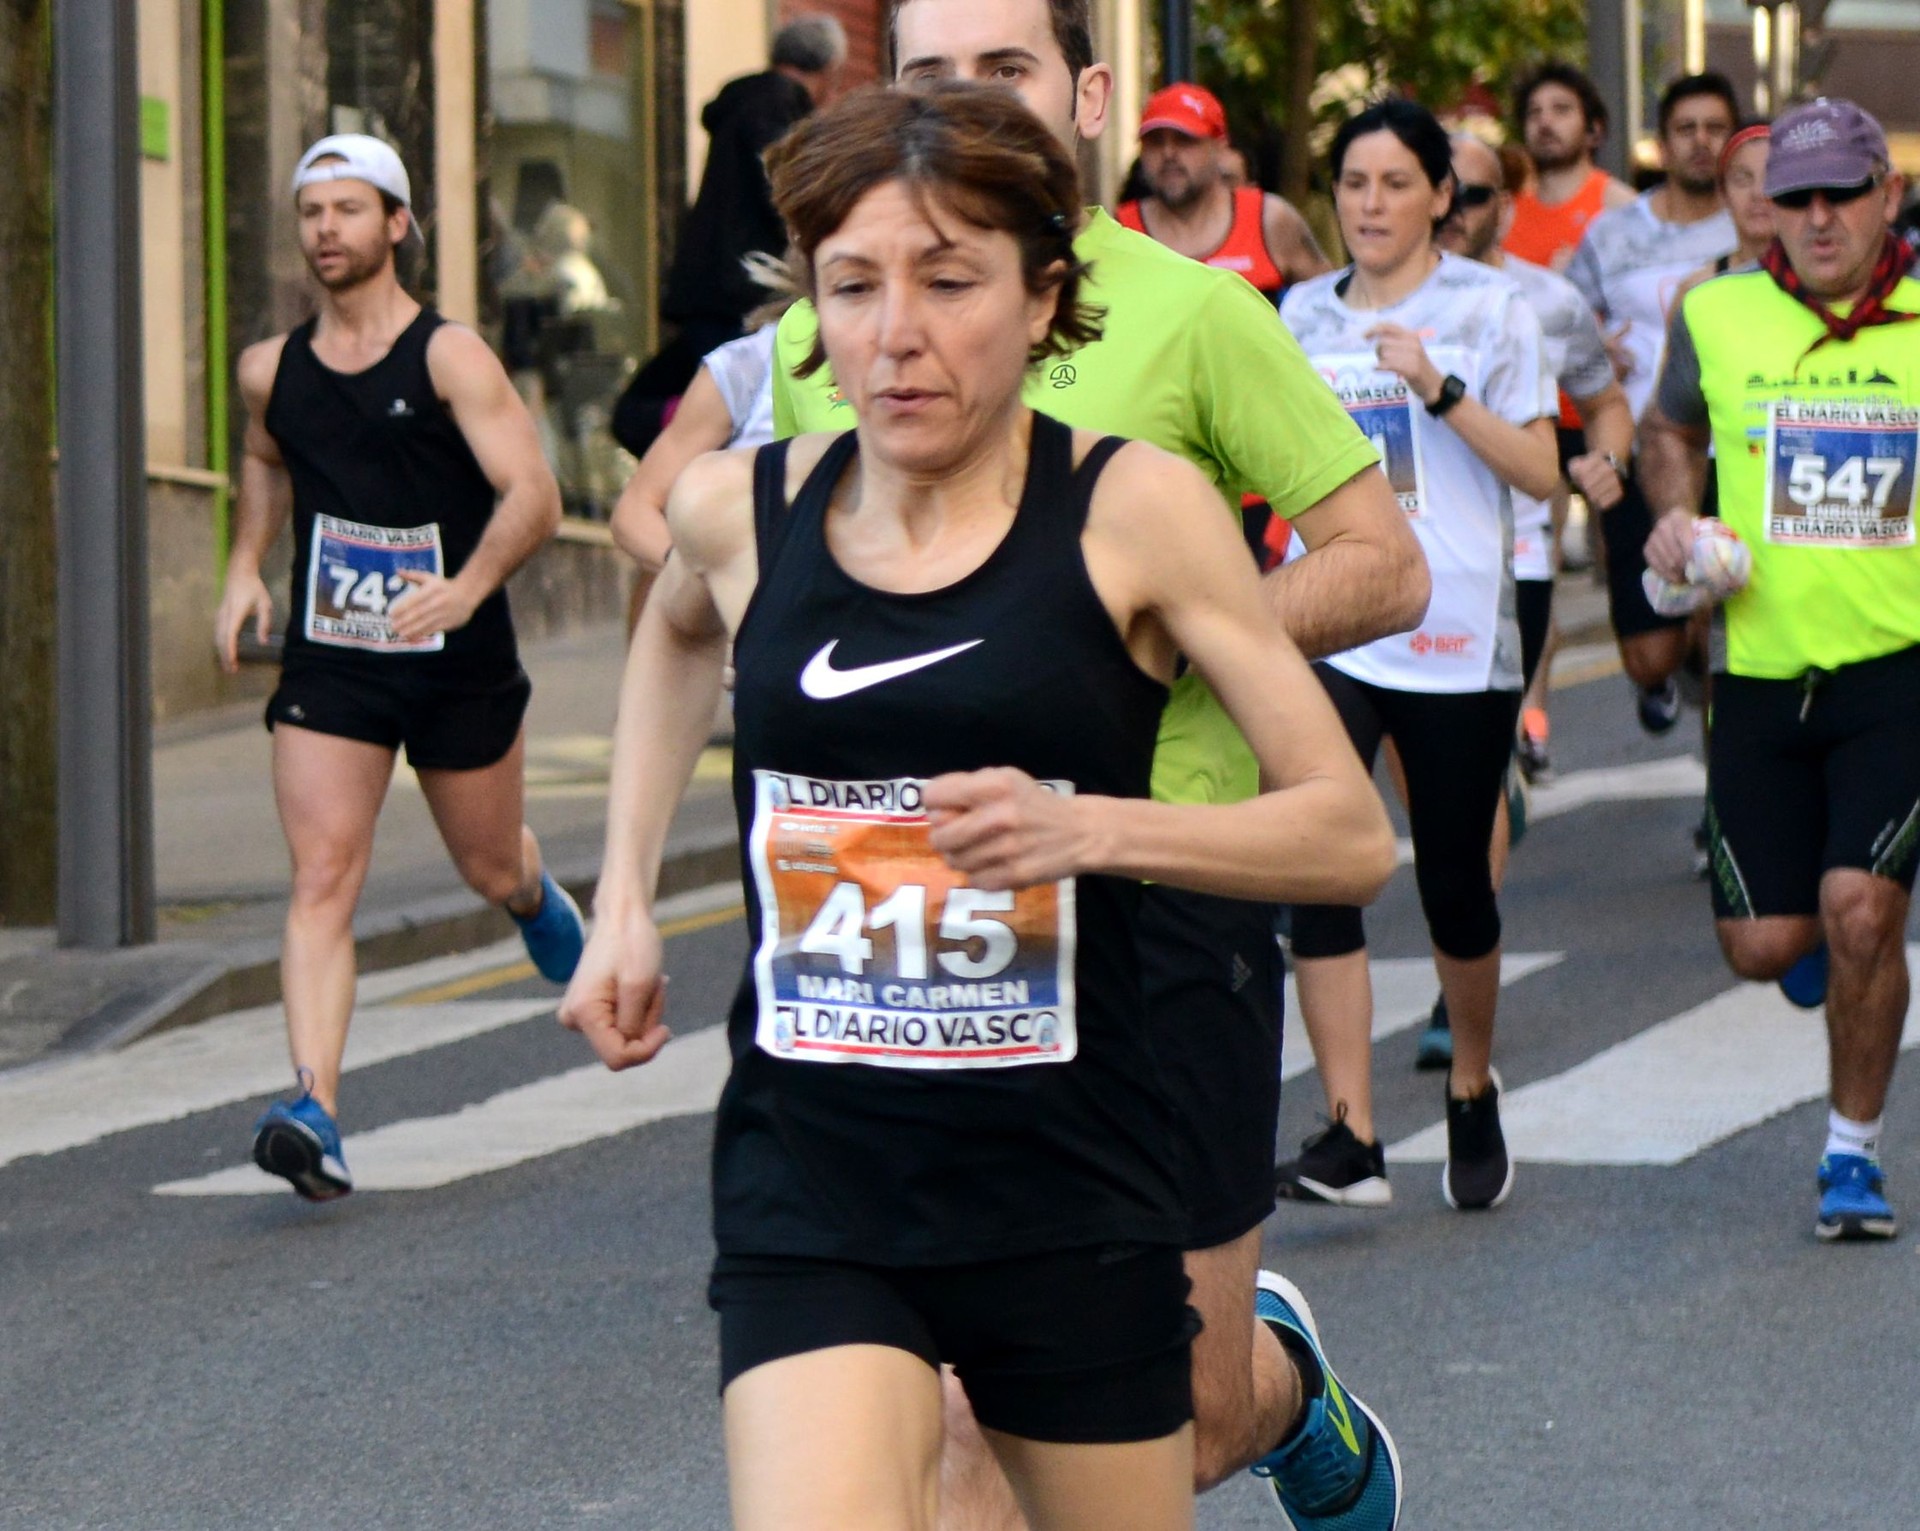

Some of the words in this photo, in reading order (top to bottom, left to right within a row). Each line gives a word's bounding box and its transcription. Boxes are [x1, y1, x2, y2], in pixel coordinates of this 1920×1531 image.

[1354, 383, 1407, 403] VASCO
[1776, 405, 1794, 422] EL
[1799, 405, 1860, 425] DIARIO
[1864, 407, 1919, 426] VASCO
[1788, 453, 1904, 511] 547
[1806, 502, 1882, 519] ENRIQUE
[1772, 517, 1788, 535] EL
[1793, 518, 1854, 538] DIARIO
[1859, 517, 1907, 539] VASCO
[769, 775, 804, 804] L
[808, 781, 921, 812] DIARIO
[800, 882, 1018, 980] 415
[796, 975, 874, 1004] MARI
[881, 980, 1029, 1009] CARMEN
[814, 1008, 928, 1047] DIARIO
